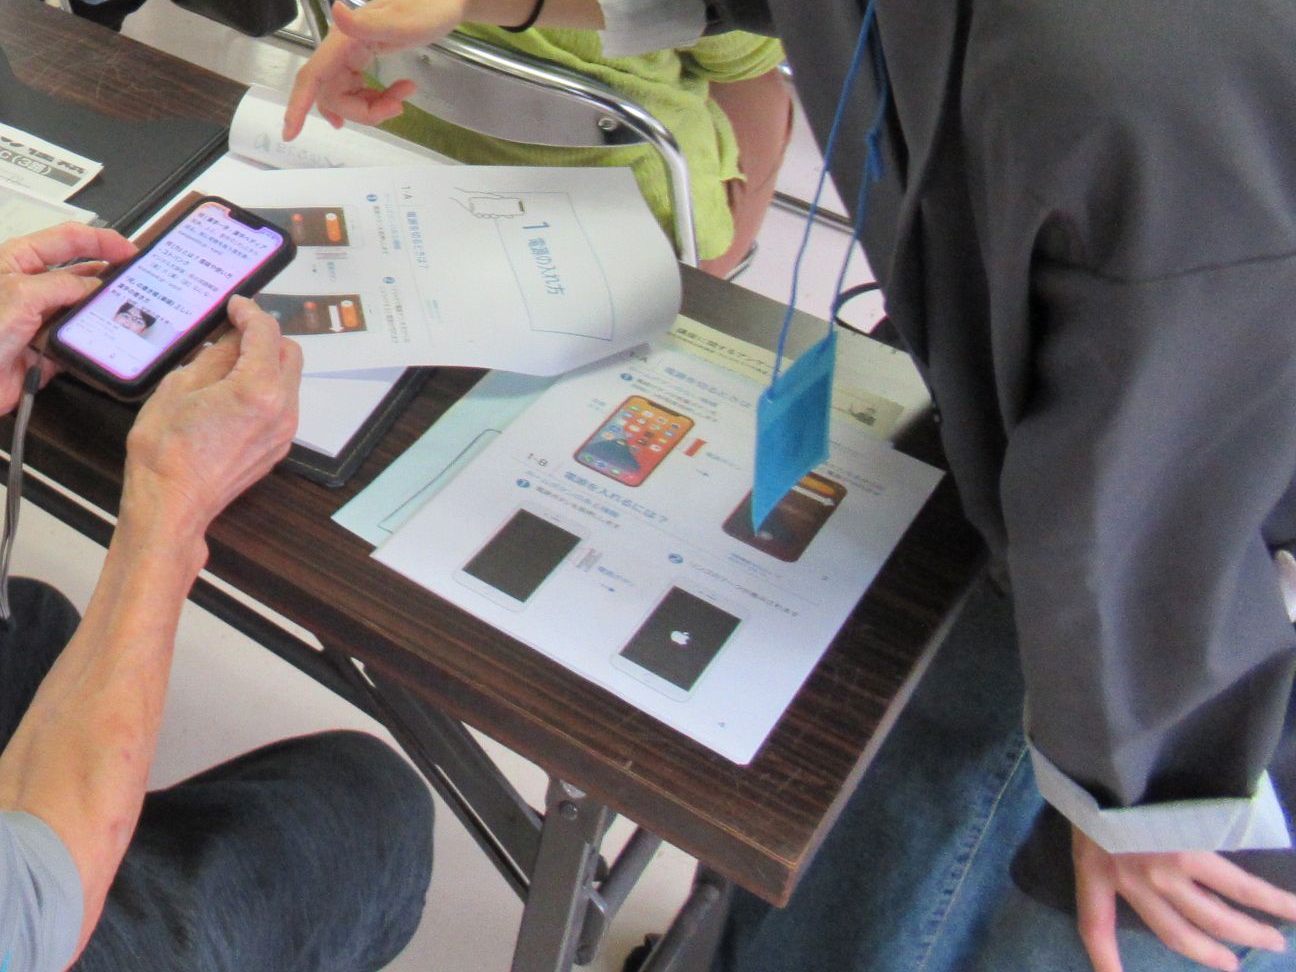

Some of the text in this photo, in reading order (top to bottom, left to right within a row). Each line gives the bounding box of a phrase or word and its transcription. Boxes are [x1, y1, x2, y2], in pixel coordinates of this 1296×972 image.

[528, 237, 565, 296] 電源の入れ方
